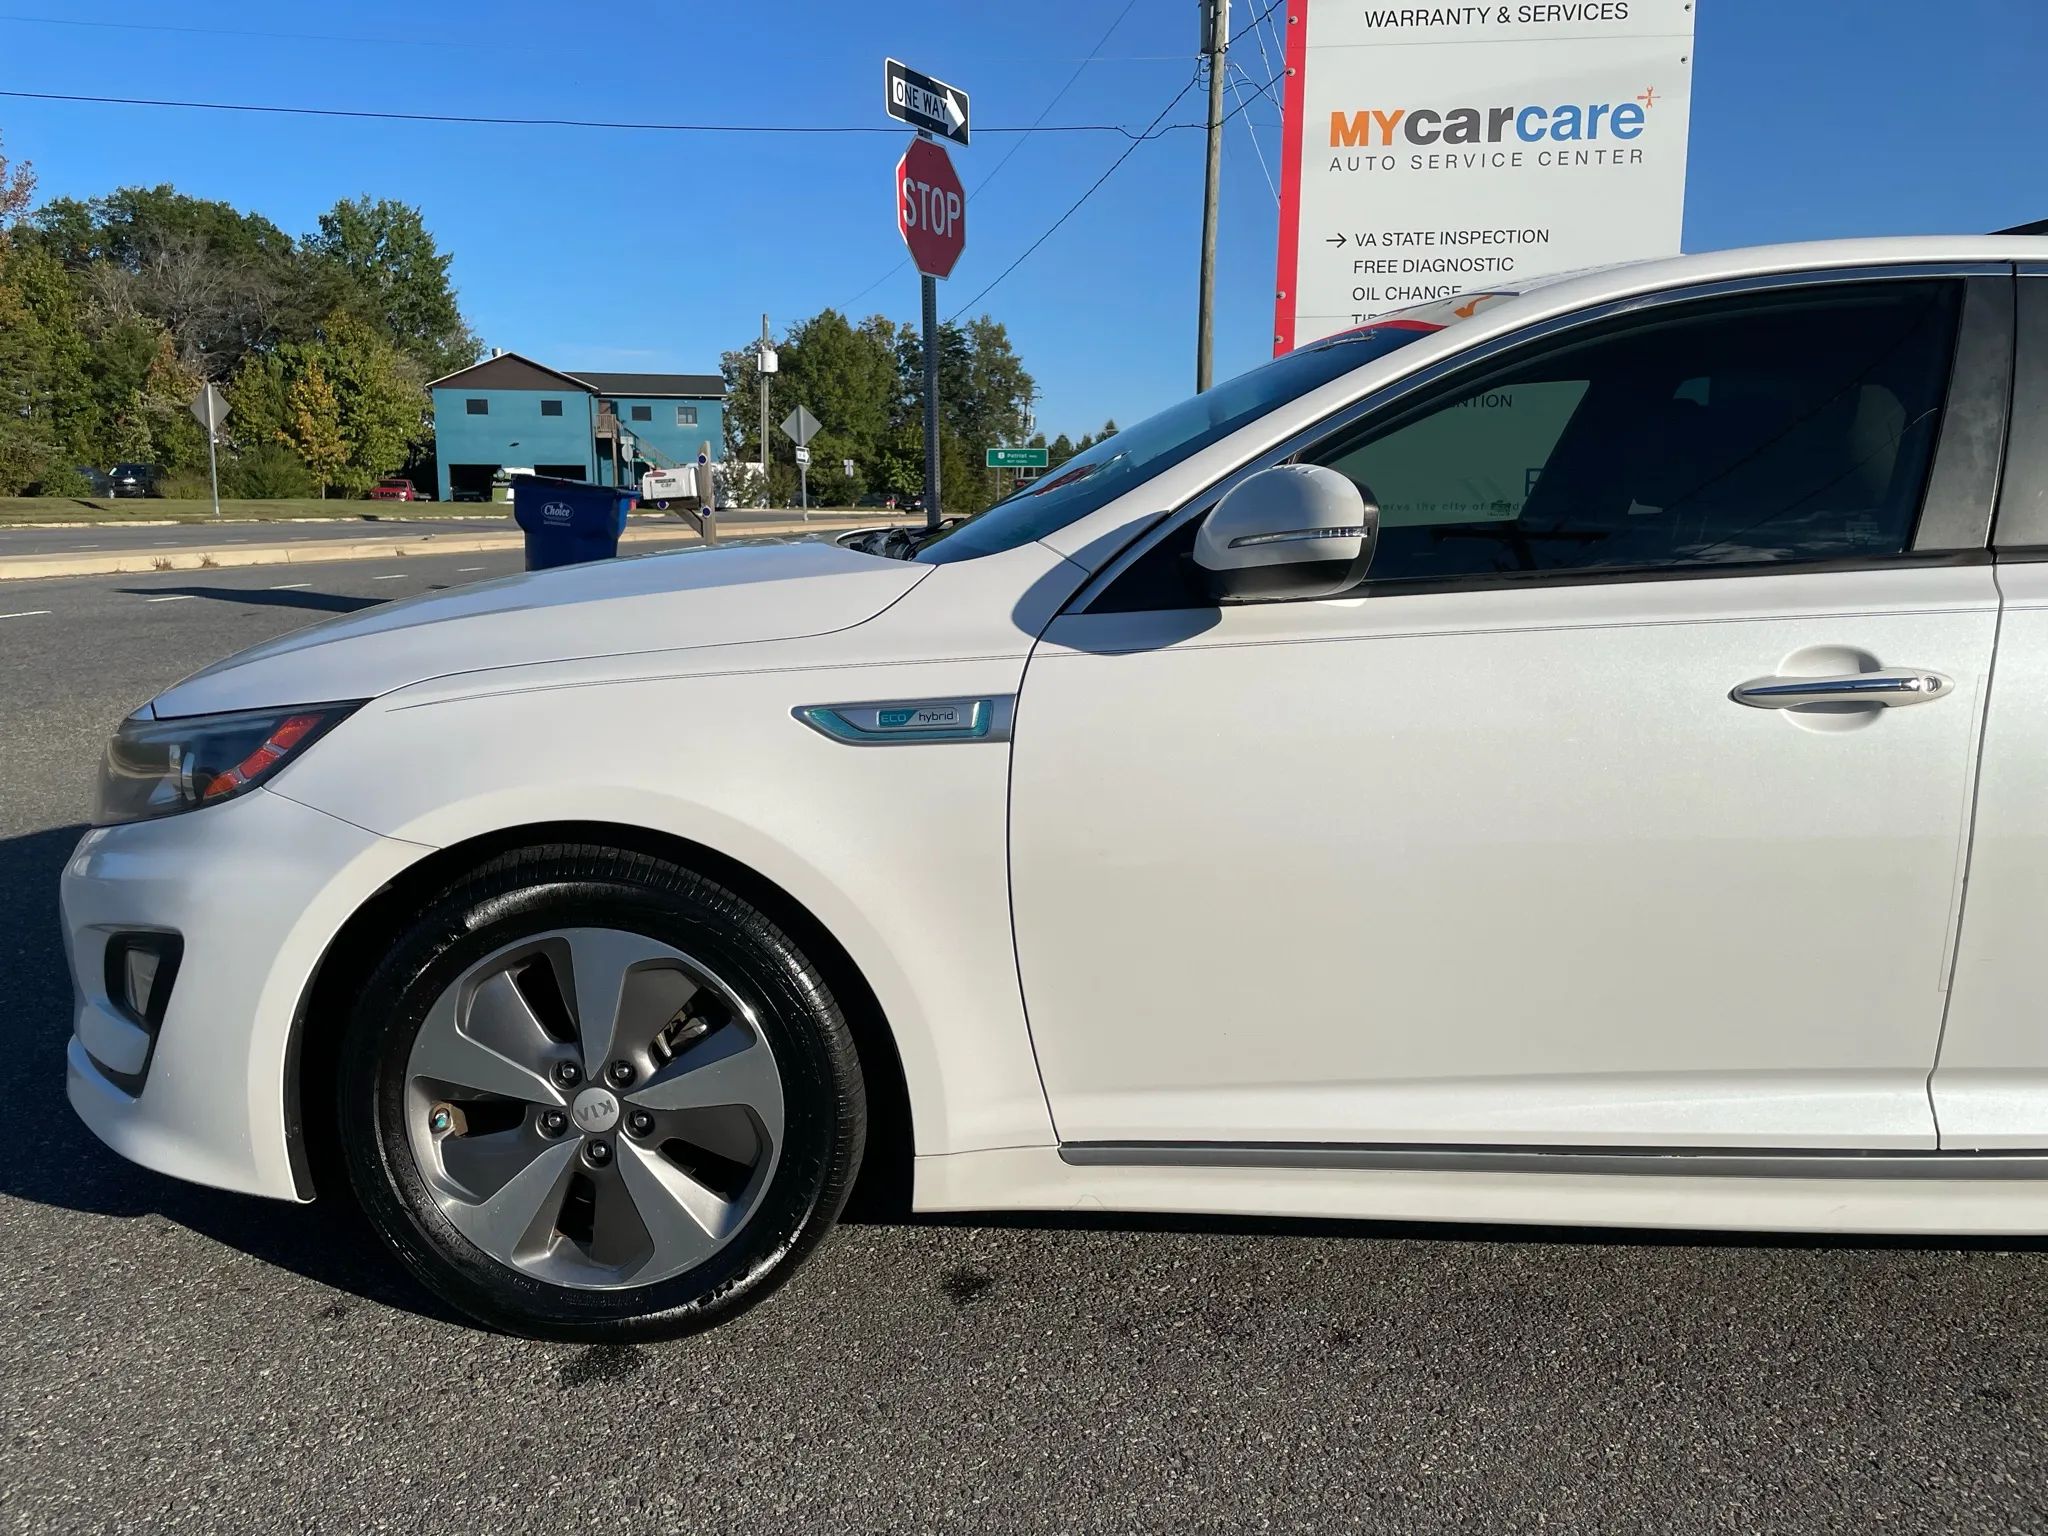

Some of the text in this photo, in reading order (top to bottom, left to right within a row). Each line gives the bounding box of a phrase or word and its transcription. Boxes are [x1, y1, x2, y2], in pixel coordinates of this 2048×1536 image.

[1365, 3, 1628, 28] WARRANTY & SERVICES
[896, 81, 947, 121] ONE WAY
[1330, 102, 1645, 147] MYcarcare
[1330, 149, 1643, 171] AUTO SERVICE CENTER
[903, 177, 961, 237] STOP
[1355, 230, 1549, 247] VA STATE INSPECTION
[1353, 257, 1514, 274] FREE DIAGNOSTIC
[1352, 287, 1380, 301] OIL
[544, 504, 570, 517] Choice
[880, 711, 954, 723] ECO hybrid
[576, 1099, 615, 1122] KIA
